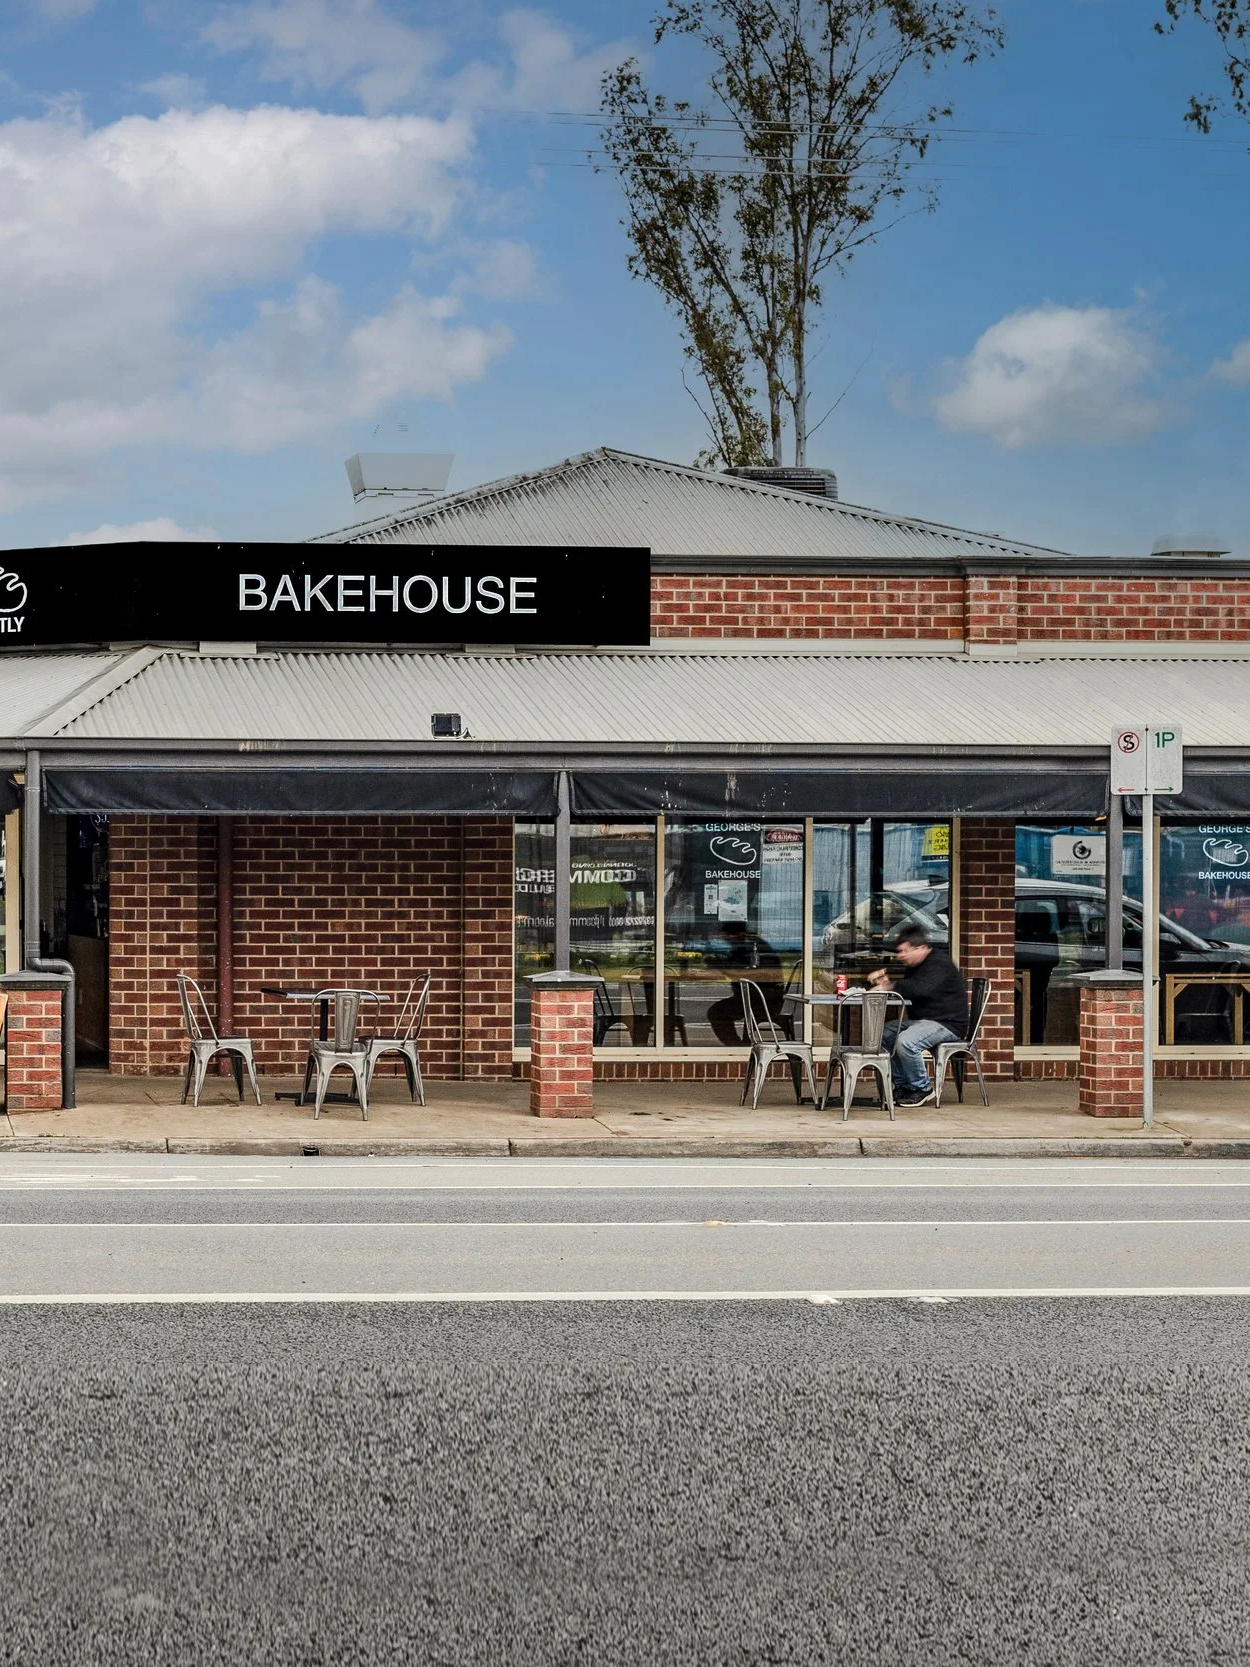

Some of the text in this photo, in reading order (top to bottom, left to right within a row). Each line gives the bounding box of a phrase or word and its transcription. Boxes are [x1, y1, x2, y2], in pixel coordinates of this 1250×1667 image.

[238, 573, 538, 615] BAKEHOUSE
[1155, 731, 1175, 748] 1P
[706, 823, 761, 832] GEORGE'S
[706, 870, 761, 879] BAKEHOUSE
